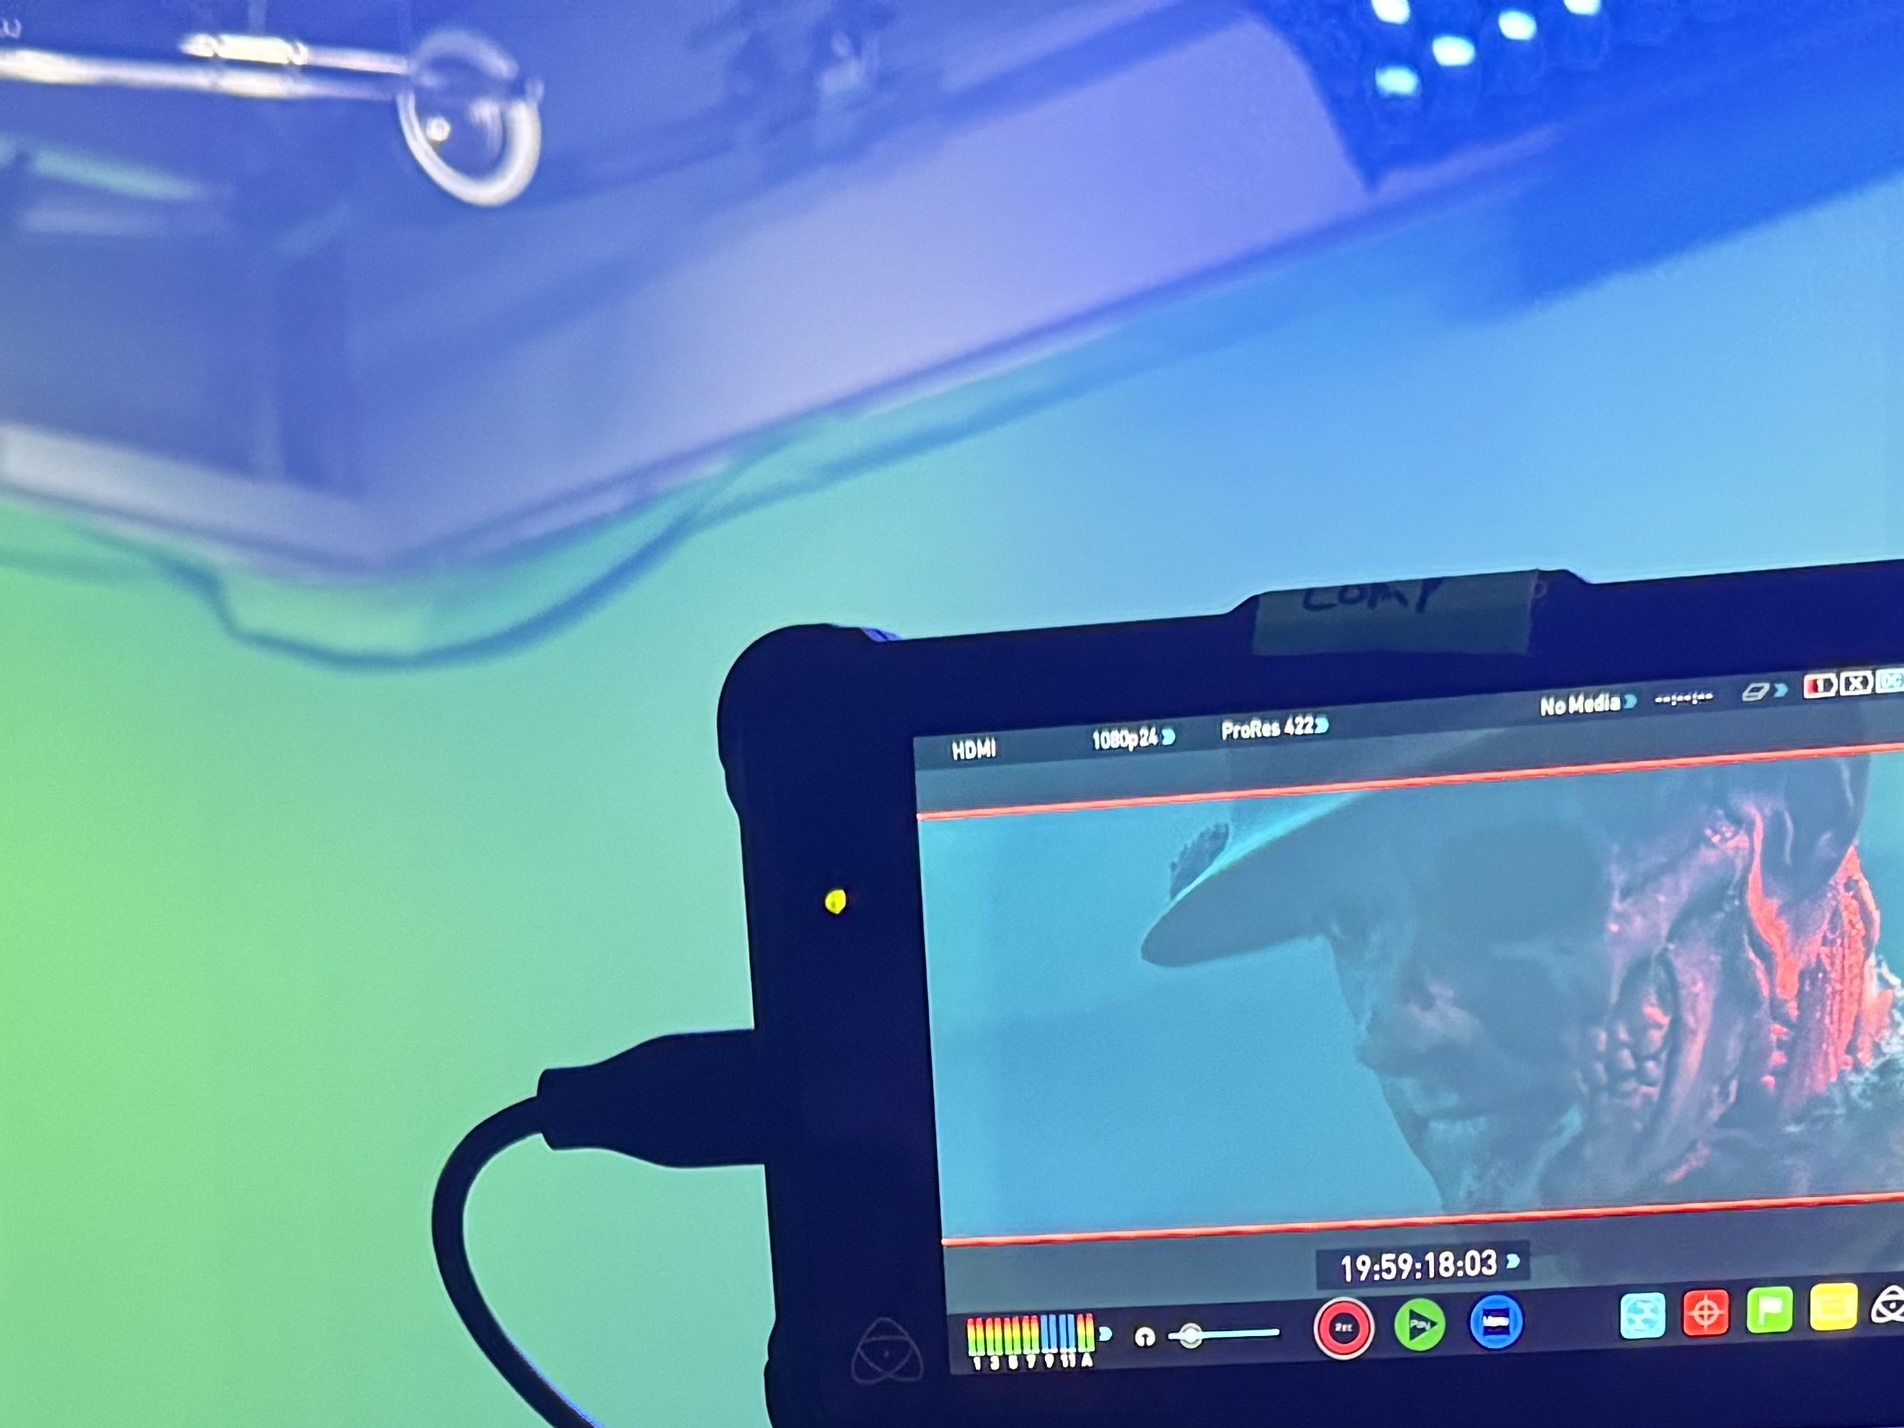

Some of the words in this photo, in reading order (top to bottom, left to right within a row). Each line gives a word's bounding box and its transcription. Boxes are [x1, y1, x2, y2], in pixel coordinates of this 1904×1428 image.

[1539, 698, 1567, 717] No
[1568, 692, 1622, 716] Media
[1092, 728, 1159, 752] 1080p24
[1221, 719, 1282, 741] ProRes
[1284, 716, 1315, 737] 422
[952, 738, 997, 761] HDMI
[1341, 1249, 1498, 1282] 19:59:18:03
